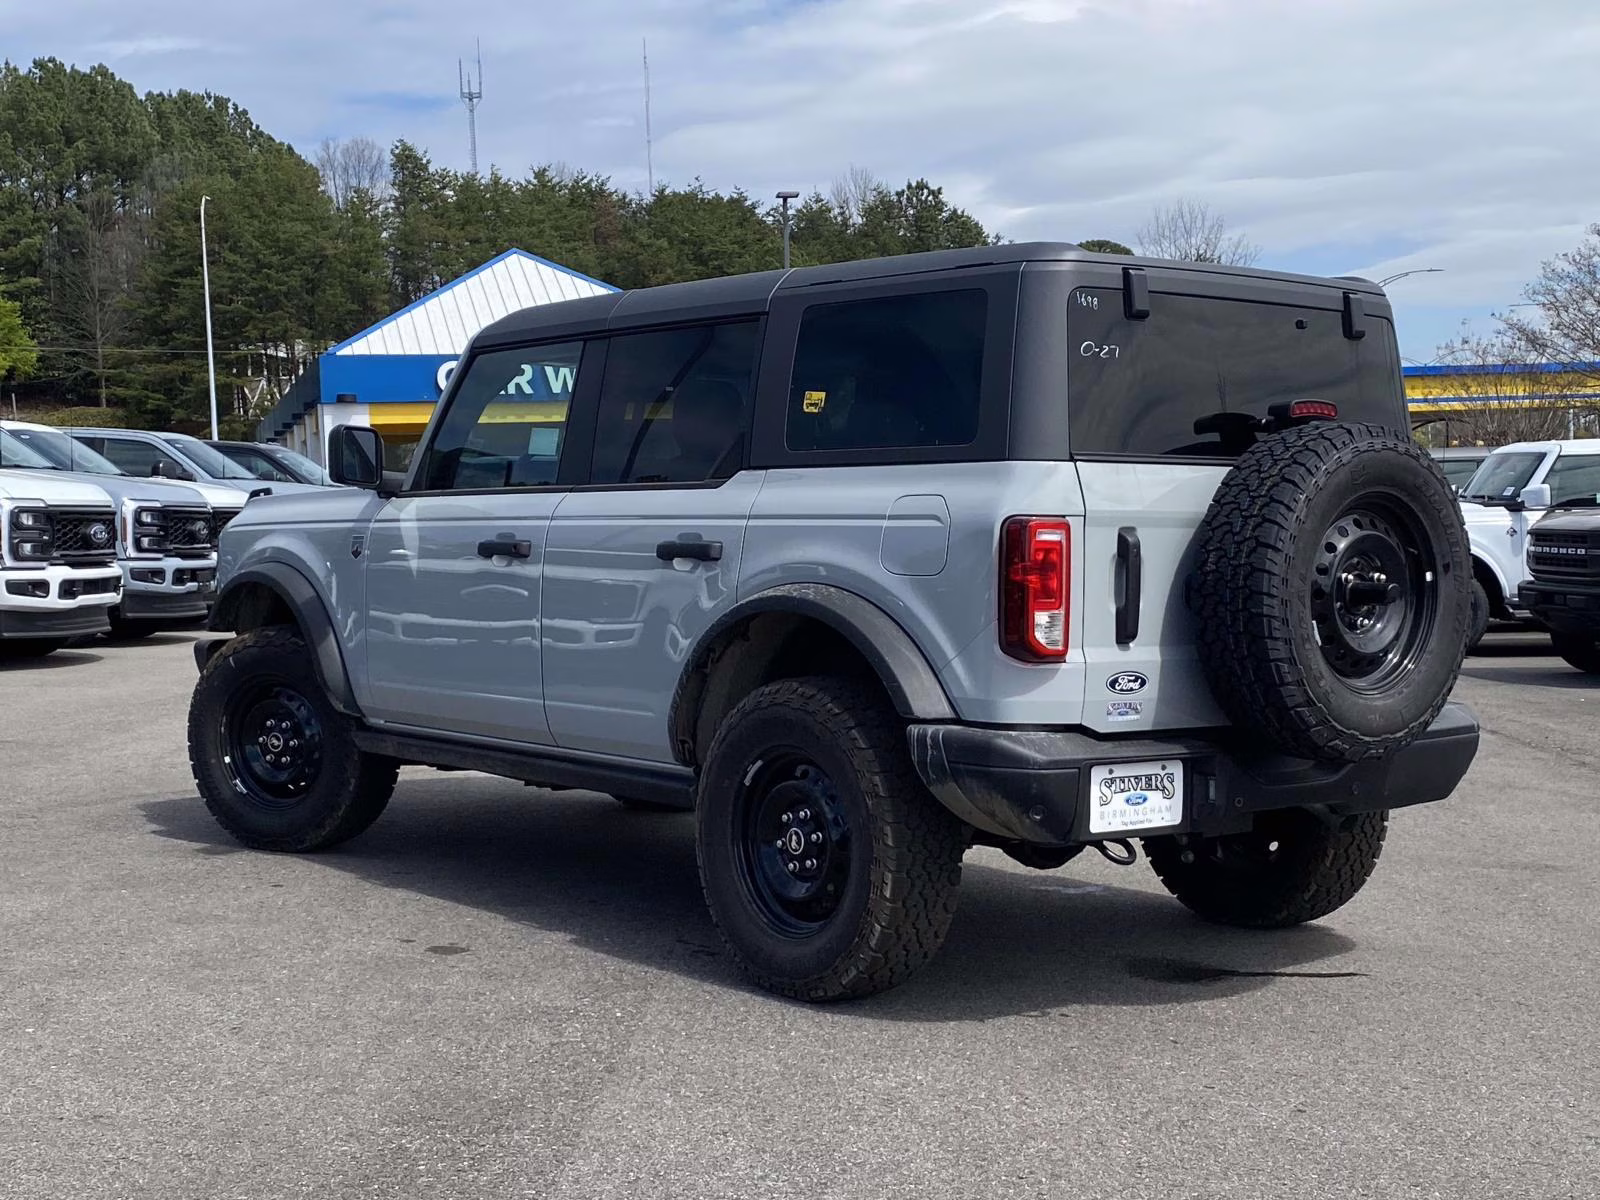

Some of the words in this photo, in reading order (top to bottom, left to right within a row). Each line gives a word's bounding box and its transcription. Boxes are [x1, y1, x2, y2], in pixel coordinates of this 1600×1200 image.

[437, 361, 534, 394] CR
[1535, 546, 1586, 555] BRONCO
[1115, 675, 1141, 691] Ford
[1099, 773, 1175, 806] STIVERS
[1100, 804, 1172, 820] BIRMINGHAM
